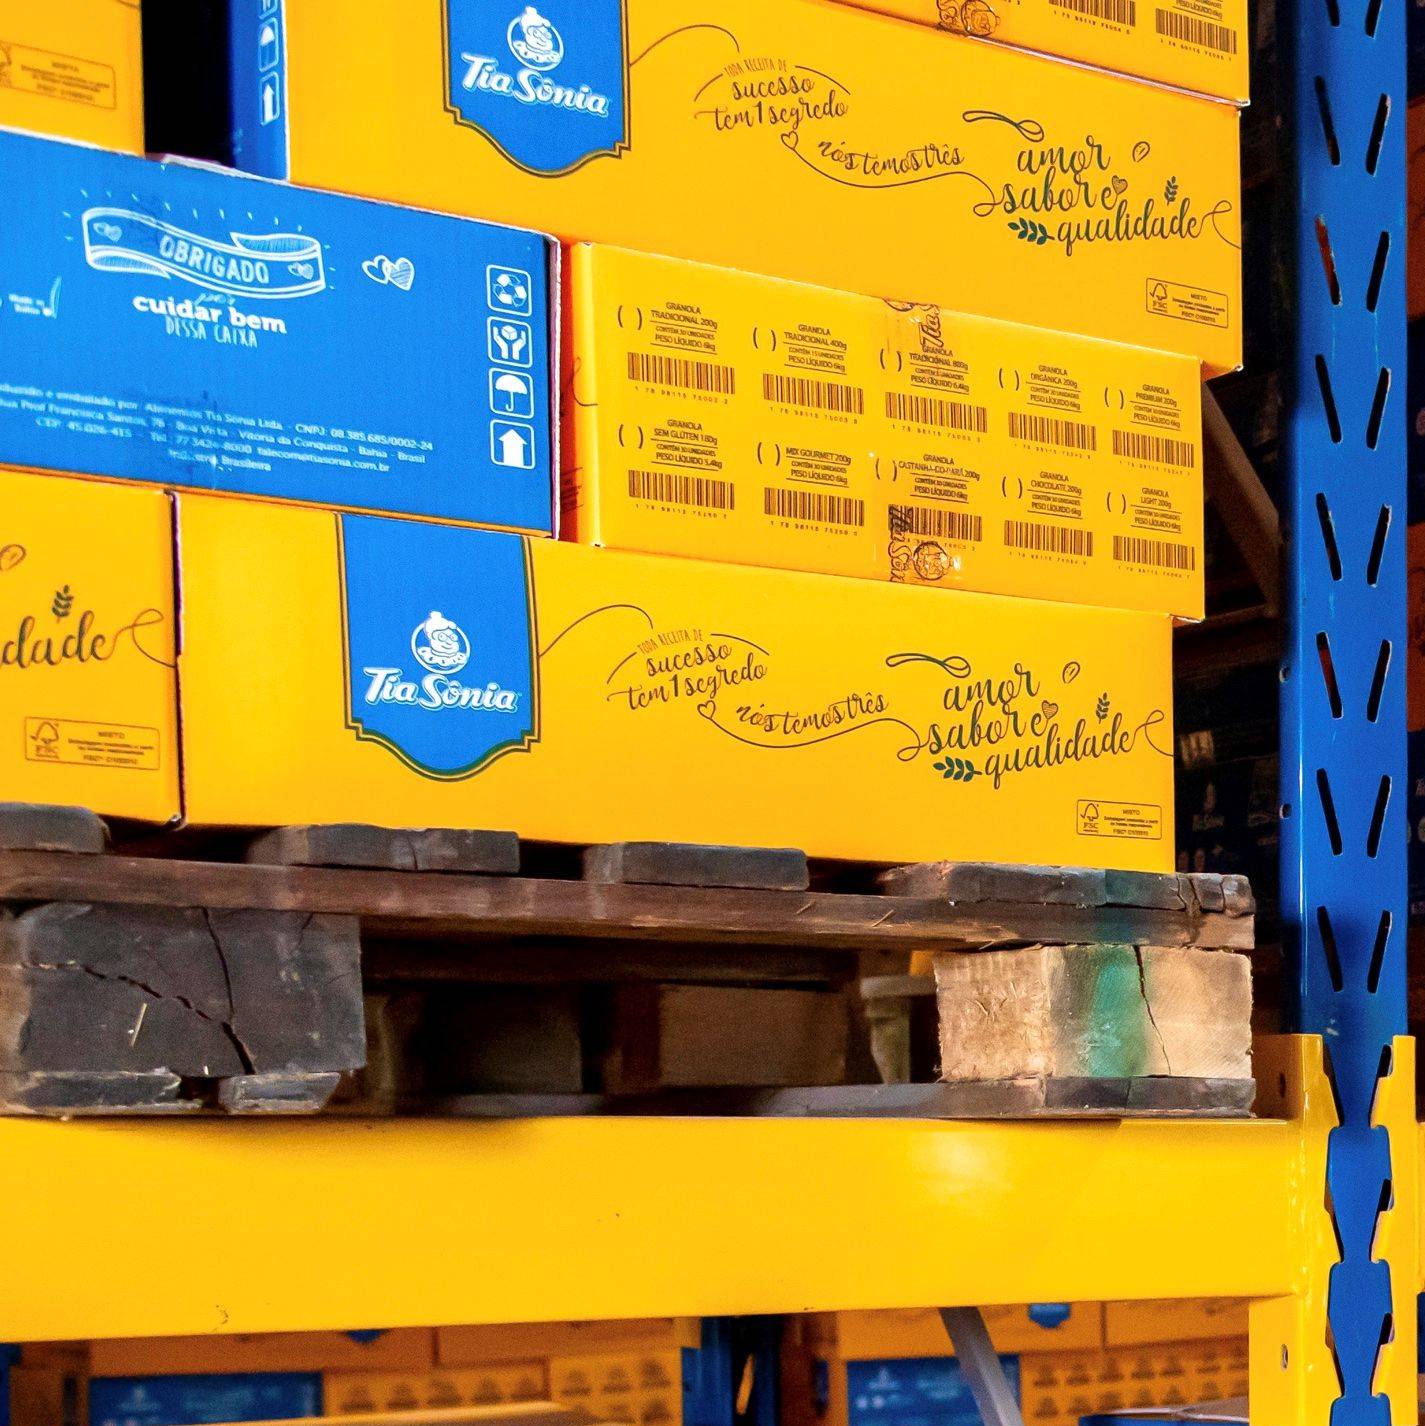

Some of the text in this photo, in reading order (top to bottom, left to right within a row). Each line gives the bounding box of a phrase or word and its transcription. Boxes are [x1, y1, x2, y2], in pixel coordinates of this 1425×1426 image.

[461, 52, 609, 117] Tia Sônia
[732, 75, 815, 100] sucesso
[703, 89, 849, 131] tem 1 segredo
[860, 149, 924, 176] temos
[923, 142, 965, 169] três
[1017, 135, 1111, 175] amor
[1003, 166, 1117, 214] sabor e
[1057, 197, 1202, 257] qualidade
[159, 234, 269, 284] OBRIGADO
[133, 295, 287, 334] cuidar bem
[650, 310, 700, 325] TRADICIONAL
[666, 302, 700, 315] GRANOLA
[165, 316, 258, 348] DESSA CAIXA
[784, 332, 829, 347] TRADICIONAL
[798, 324, 831, 337] GRANOLA
[667, 419, 703, 432] GRANOLA
[800, 448, 835, 460] GOURMET
[637, 638, 658, 655] TODA
[658, 629, 691, 647] RECEITA
[646, 643, 732, 677] sucesso
[363, 667, 518, 713] Tia Sônia
[619, 652, 768, 711] tem 1 segredo
[944, 662, 1041, 712] amor
[781, 703, 846, 735] temos
[845, 692, 889, 720] três
[928, 699, 1048, 756] sabor e
[985, 712, 1135, 790] qualidade
